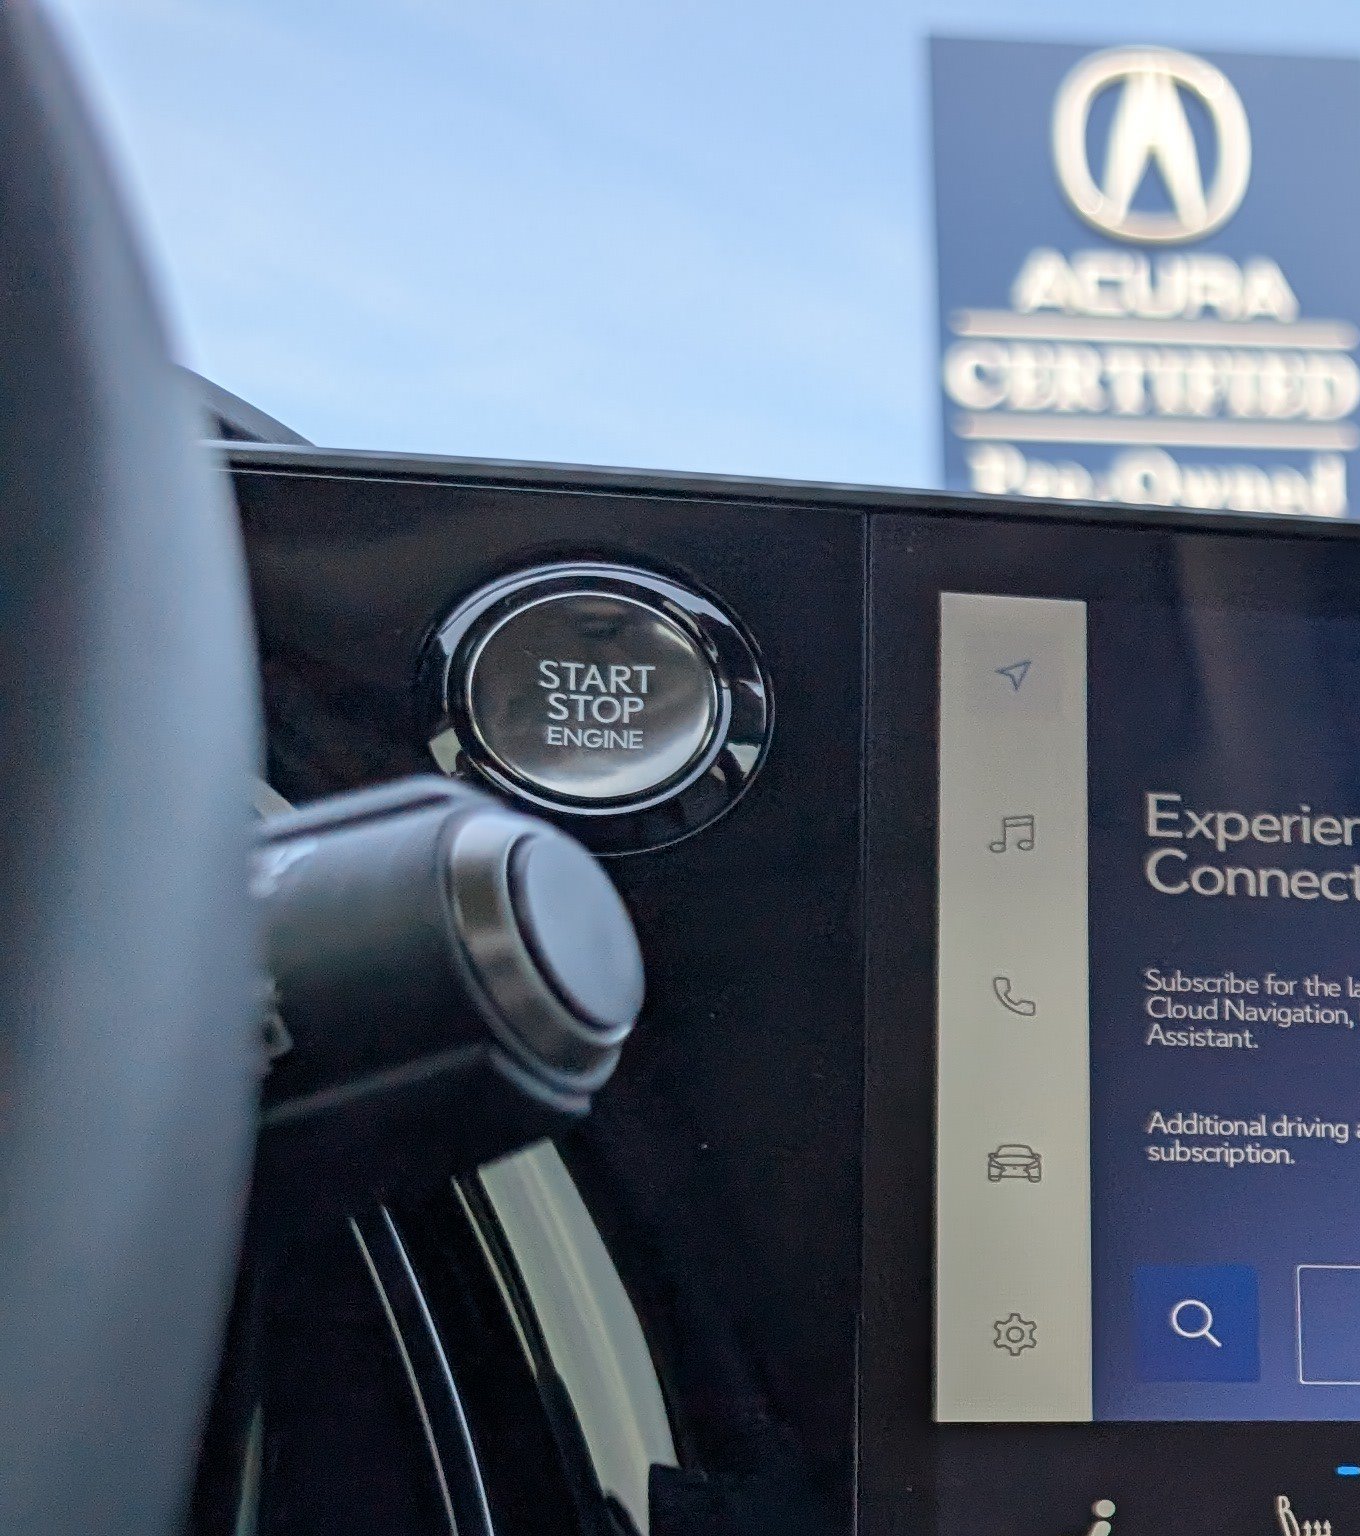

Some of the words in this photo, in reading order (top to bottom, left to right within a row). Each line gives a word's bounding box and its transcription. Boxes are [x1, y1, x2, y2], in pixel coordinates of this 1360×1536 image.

[1013, 248, 1298, 321] ACURA
[538, 659, 656, 694] START
[547, 692, 644, 724] STOP
[547, 727, 643, 749] ENGINE
[1146, 968, 1259, 996] Subscribe
[1265, 973, 1298, 997] for
[1303, 976, 1341, 998] the
[1147, 996, 1218, 1021] Cloud
[1225, 1000, 1354, 1029] Navigation,
[1147, 1024, 1259, 1049] Assistant.
[1149, 1112, 1267, 1137] Additional
[1273, 1115, 1350, 1144] driving
[1148, 1141, 1296, 1168] subscription.
